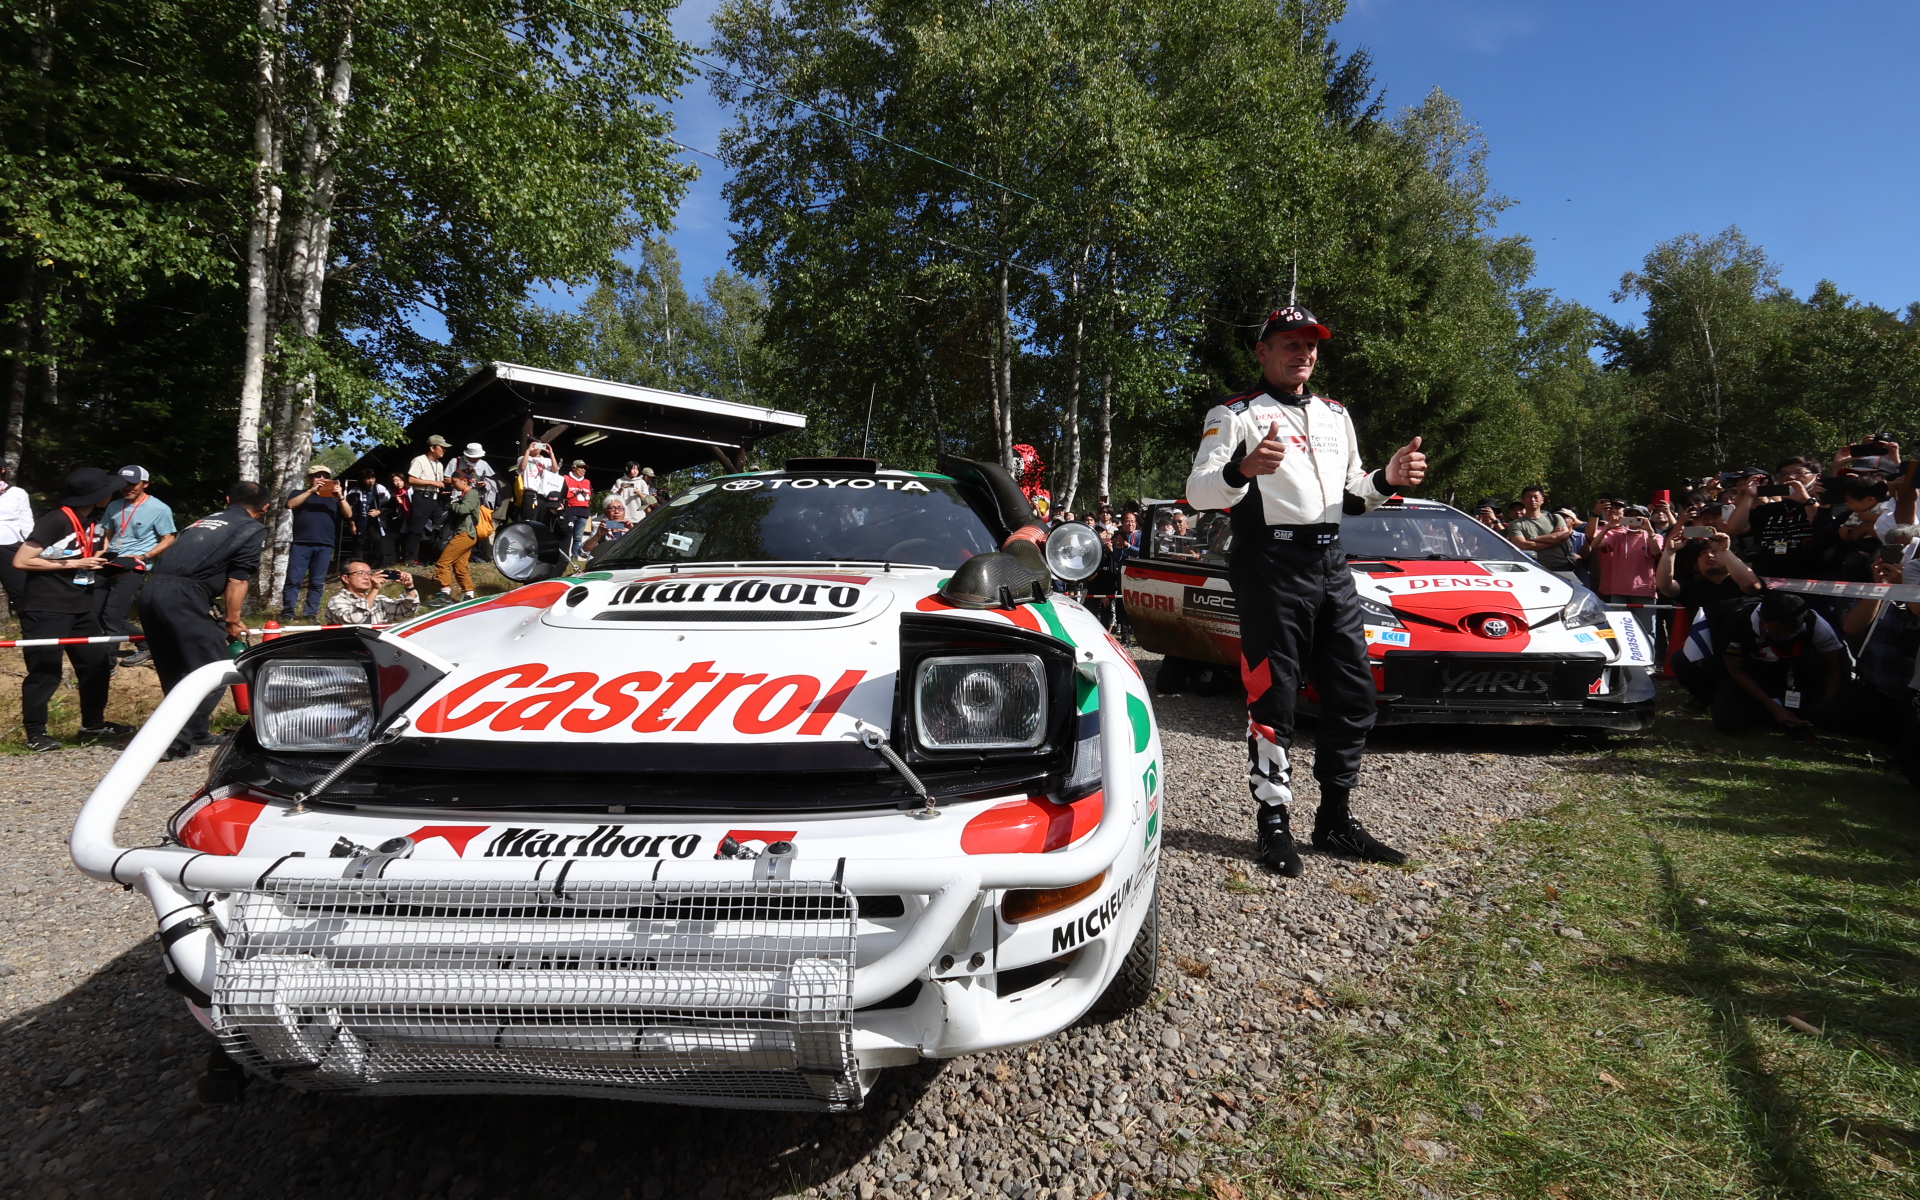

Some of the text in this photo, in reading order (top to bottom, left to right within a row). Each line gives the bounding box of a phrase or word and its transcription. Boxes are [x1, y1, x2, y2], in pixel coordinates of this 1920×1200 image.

[1285, 311, 1304, 322] #8
[1255, 412, 1285, 420] DENSO
[769, 478, 931, 492] TOYOTA
[1273, 531, 1294, 540] OMP
[607, 579, 861, 608] Marlboro
[1408, 578, 1514, 590] DENSO
[1123, 589, 1175, 613] MORI
[1193, 593, 1236, 609] WRC
[1620, 616, 1646, 662] Panasonic
[415, 660, 868, 736] Castrol
[482, 824, 702, 859] Marlboro
[1051, 873, 1134, 954] MICHELIN
